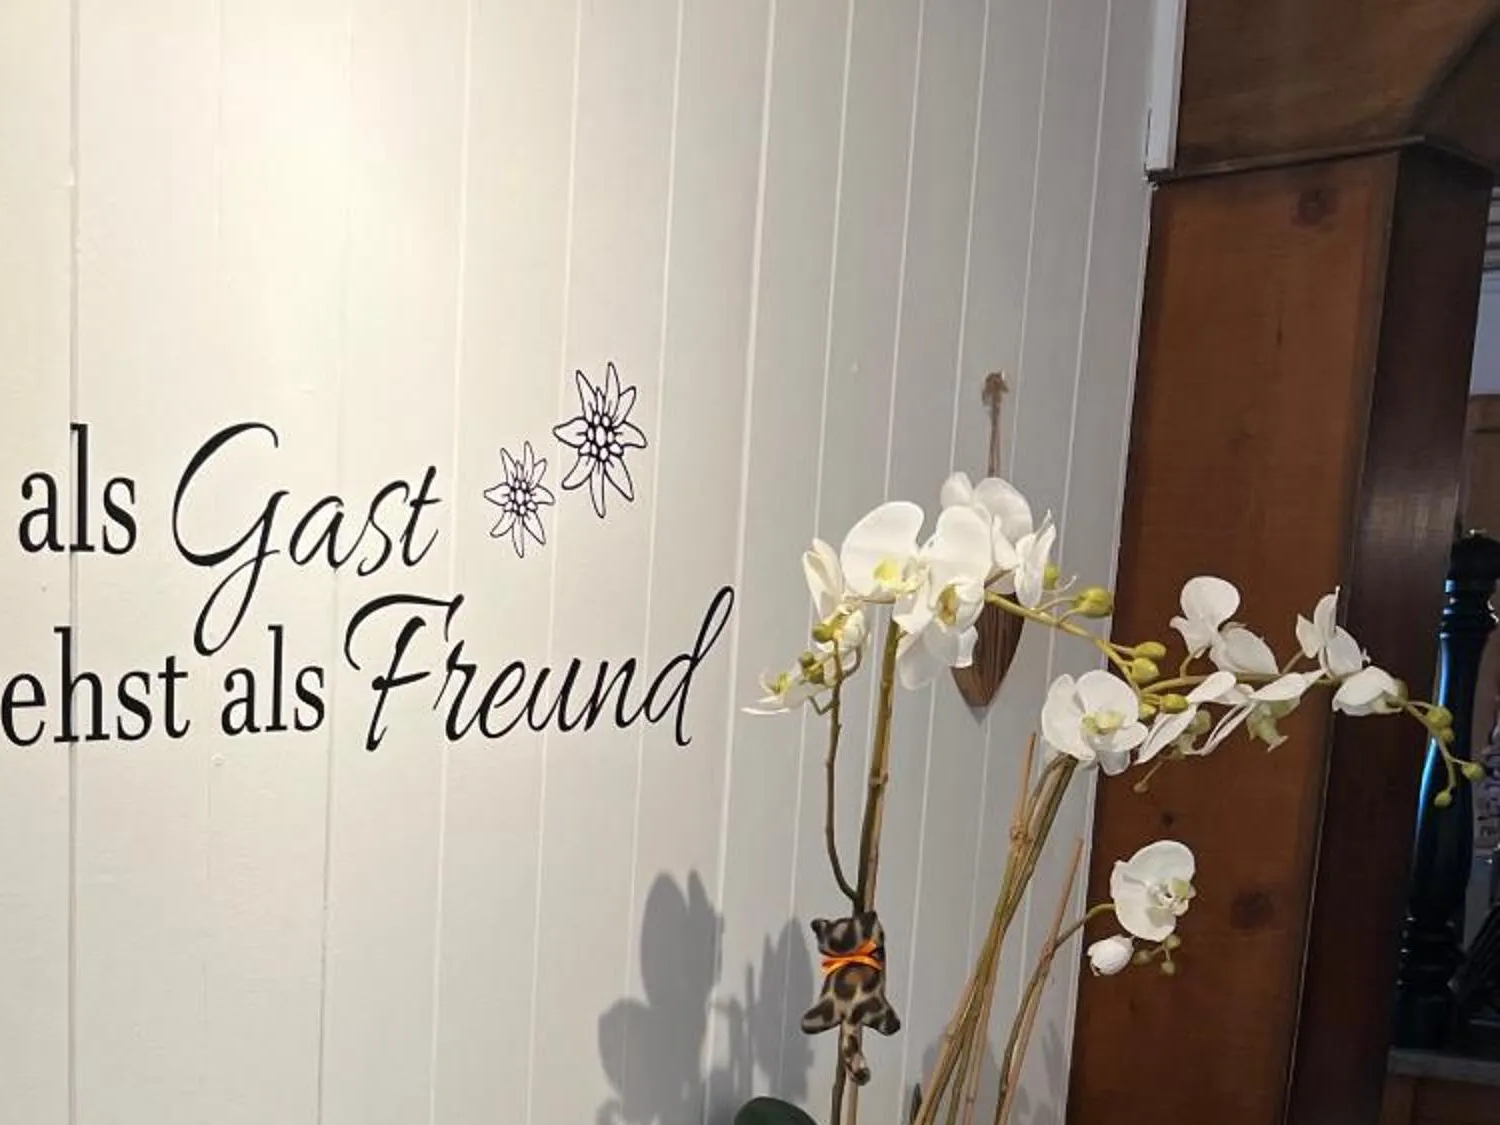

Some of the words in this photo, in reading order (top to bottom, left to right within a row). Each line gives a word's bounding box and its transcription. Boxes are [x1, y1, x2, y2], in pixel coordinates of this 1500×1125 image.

[19, 423, 137, 555] als
[172, 422, 441, 657] Gast
[221, 625, 325, 736] als
[343, 585, 736, 752] Freund
